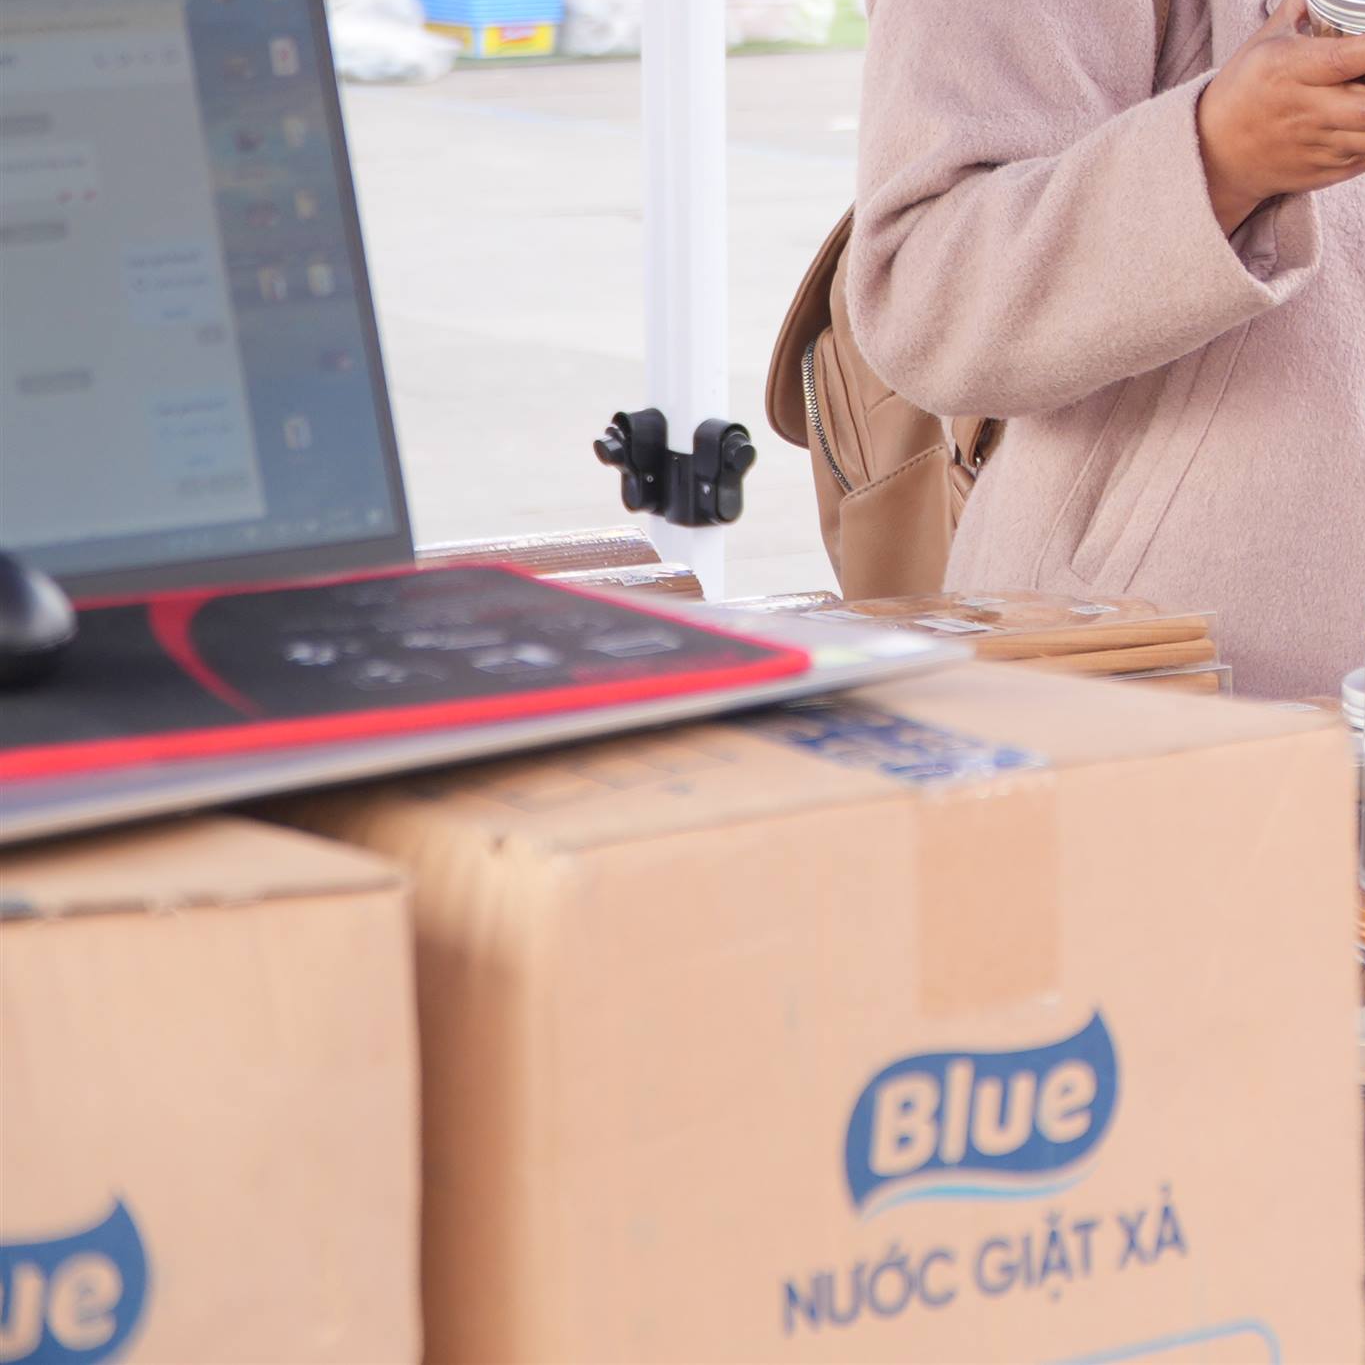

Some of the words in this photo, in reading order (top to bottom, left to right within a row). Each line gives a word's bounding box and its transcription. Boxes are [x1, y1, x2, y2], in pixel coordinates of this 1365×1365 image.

[869, 1057, 1098, 1178] Blue
[780, 1243, 957, 1336] NƯỚC
[975, 1211, 1100, 1303] GIẶT
[1115, 1181, 1189, 1272] XẢ
